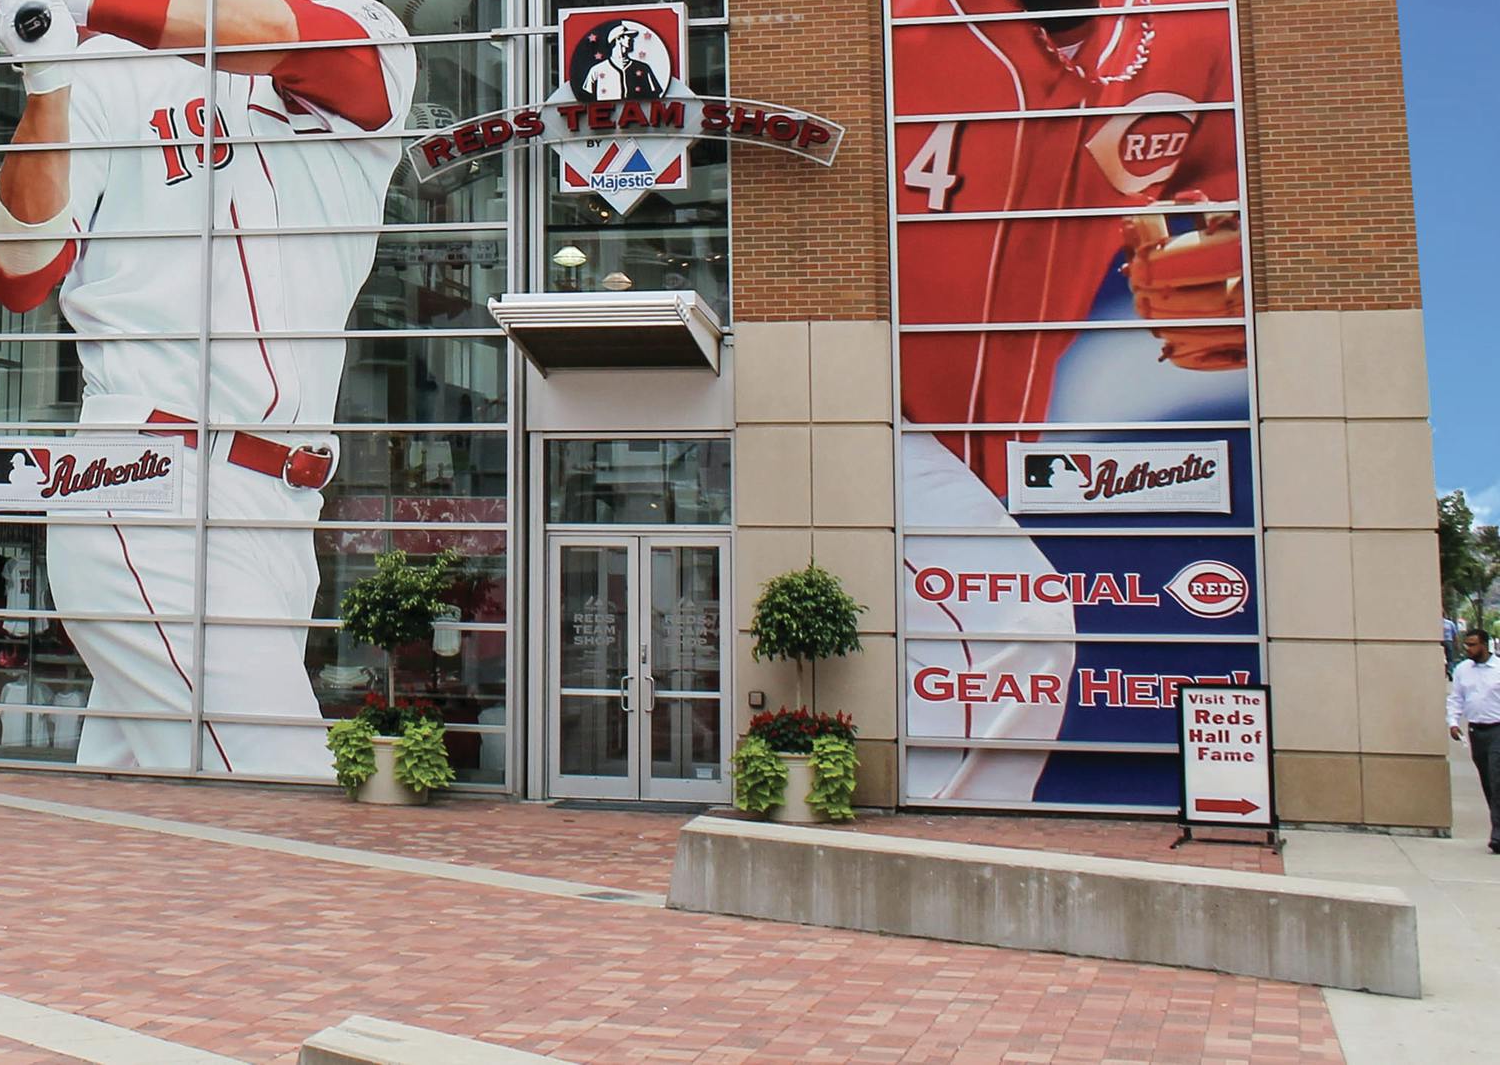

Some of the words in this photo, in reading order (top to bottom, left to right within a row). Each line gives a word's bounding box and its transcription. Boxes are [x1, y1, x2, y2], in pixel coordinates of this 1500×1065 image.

[149, 97, 234, 186] 19
[421, 111, 545, 167] REDS
[557, 99, 685, 131] TEAM
[702, 103, 831, 148] SHOP
[587, 140, 602, 148] BY
[904, 121, 957, 211] 4
[590, 174, 654, 193] Majestic
[41, 449, 171, 499] Authentic
[1084, 453, 1217, 501] Authentic
[913, 566, 1160, 607] OFFICIAL
[1190, 581, 1244, 597] REDS
[573, 613, 616, 624] REDS
[665, 614, 706, 625] REDS
[573, 625, 616, 635] TEAM
[573, 636, 616, 646] SHOP
[913, 666, 1062, 704] GEAR
[1188, 694, 1225, 705] Visit
[1232, 694, 1261, 705] The
[1195, 709, 1255, 726] Reds
[1188, 729, 1230, 744] Hall
[1241, 730, 1263, 744] of
[1197, 747, 1255, 762] Fame
